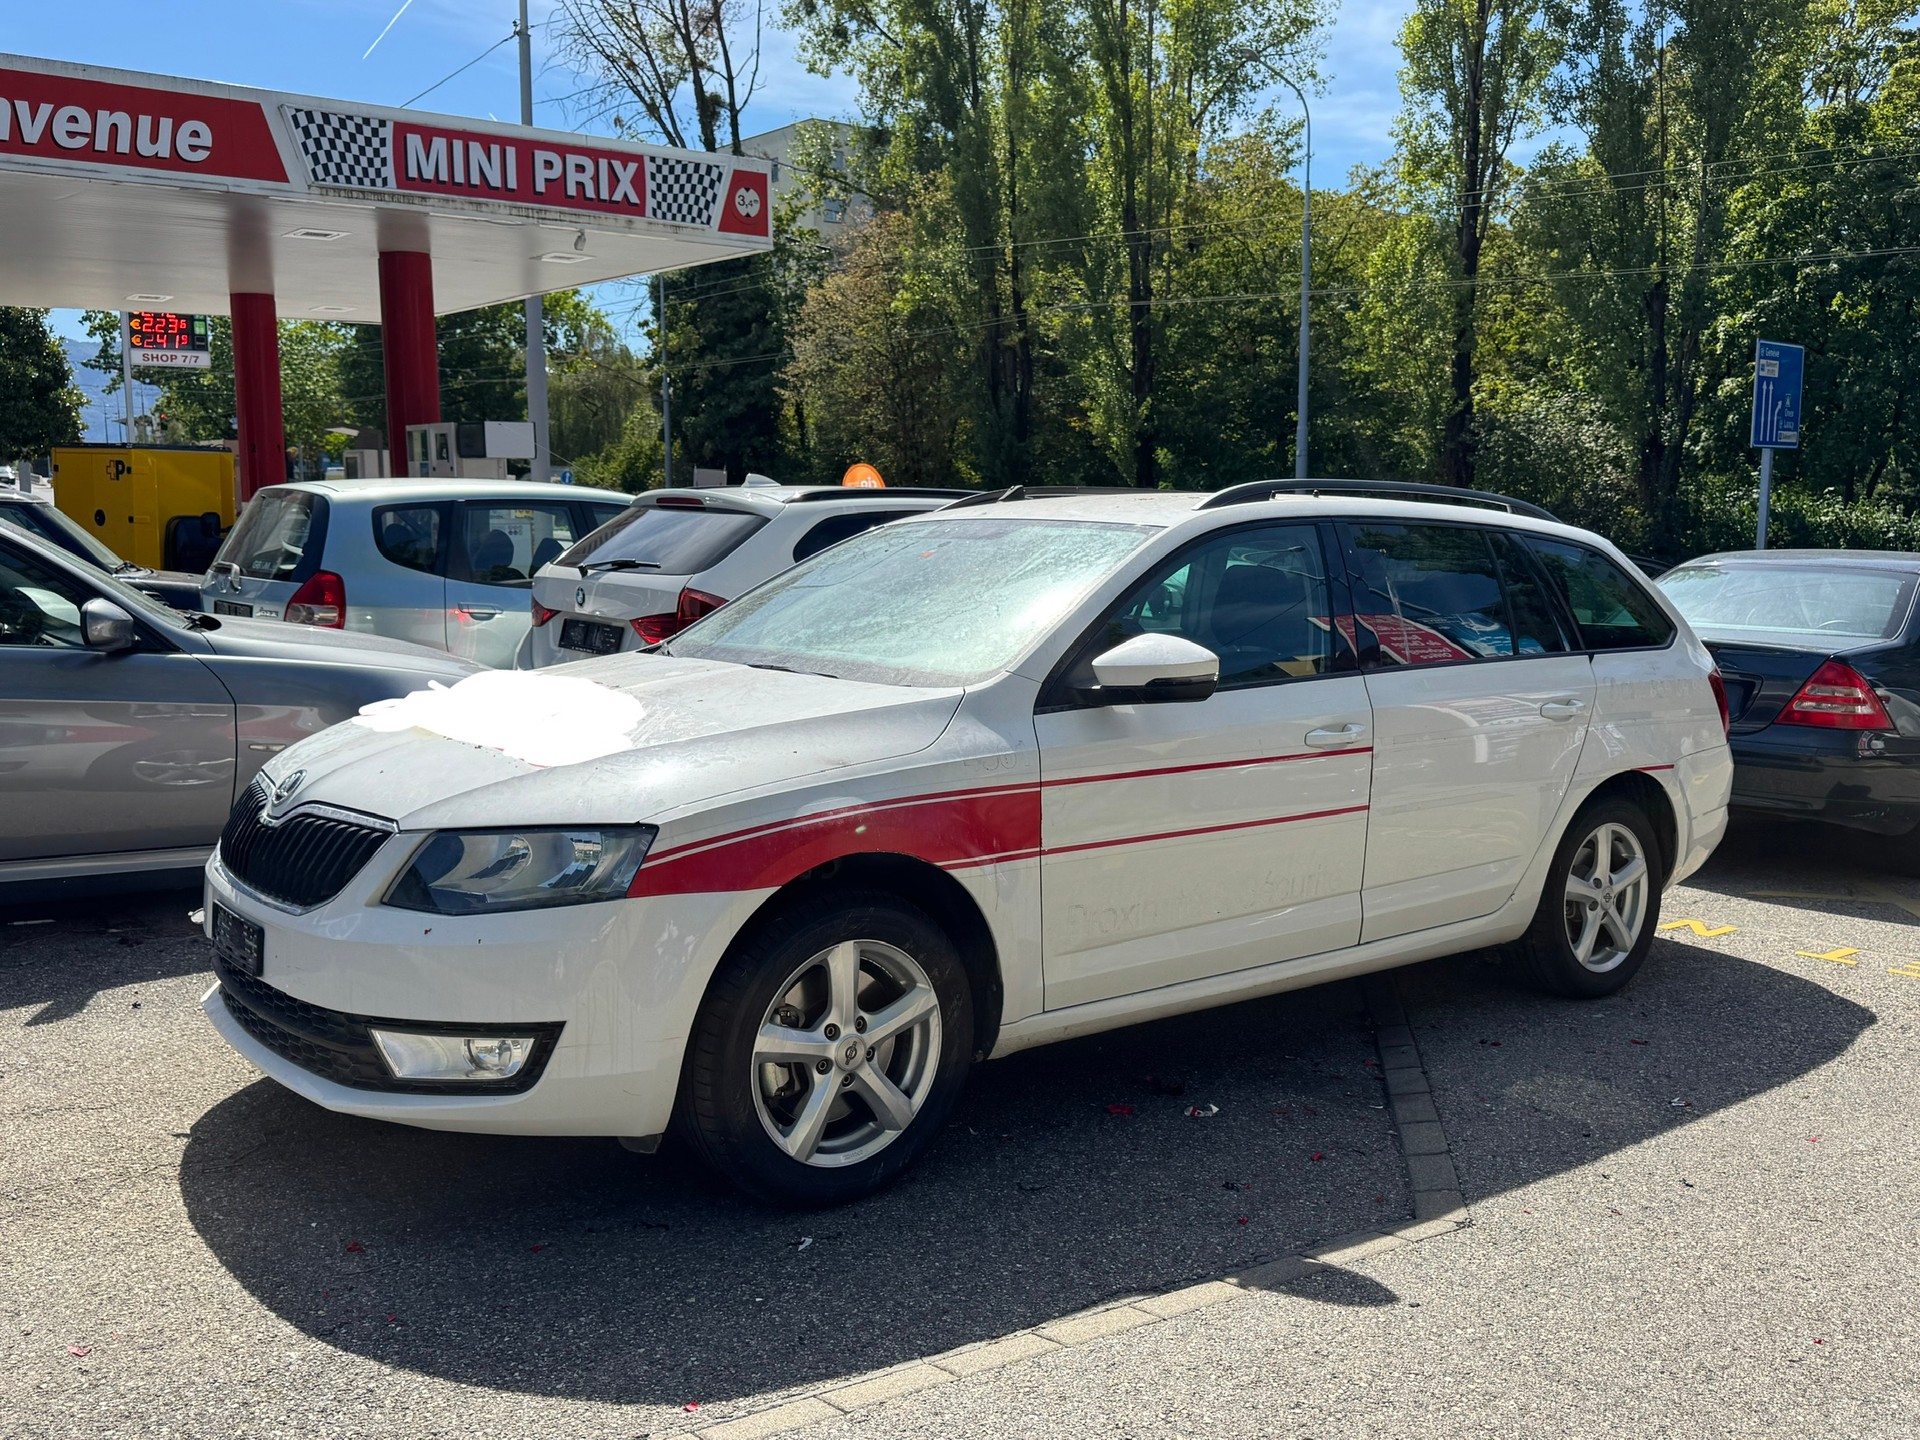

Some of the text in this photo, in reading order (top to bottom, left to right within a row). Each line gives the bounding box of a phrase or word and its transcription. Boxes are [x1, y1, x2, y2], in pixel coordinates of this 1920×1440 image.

[405, 133, 641, 205] MINI PRIX
[142, 353, 200, 364] SHOP 7/7
